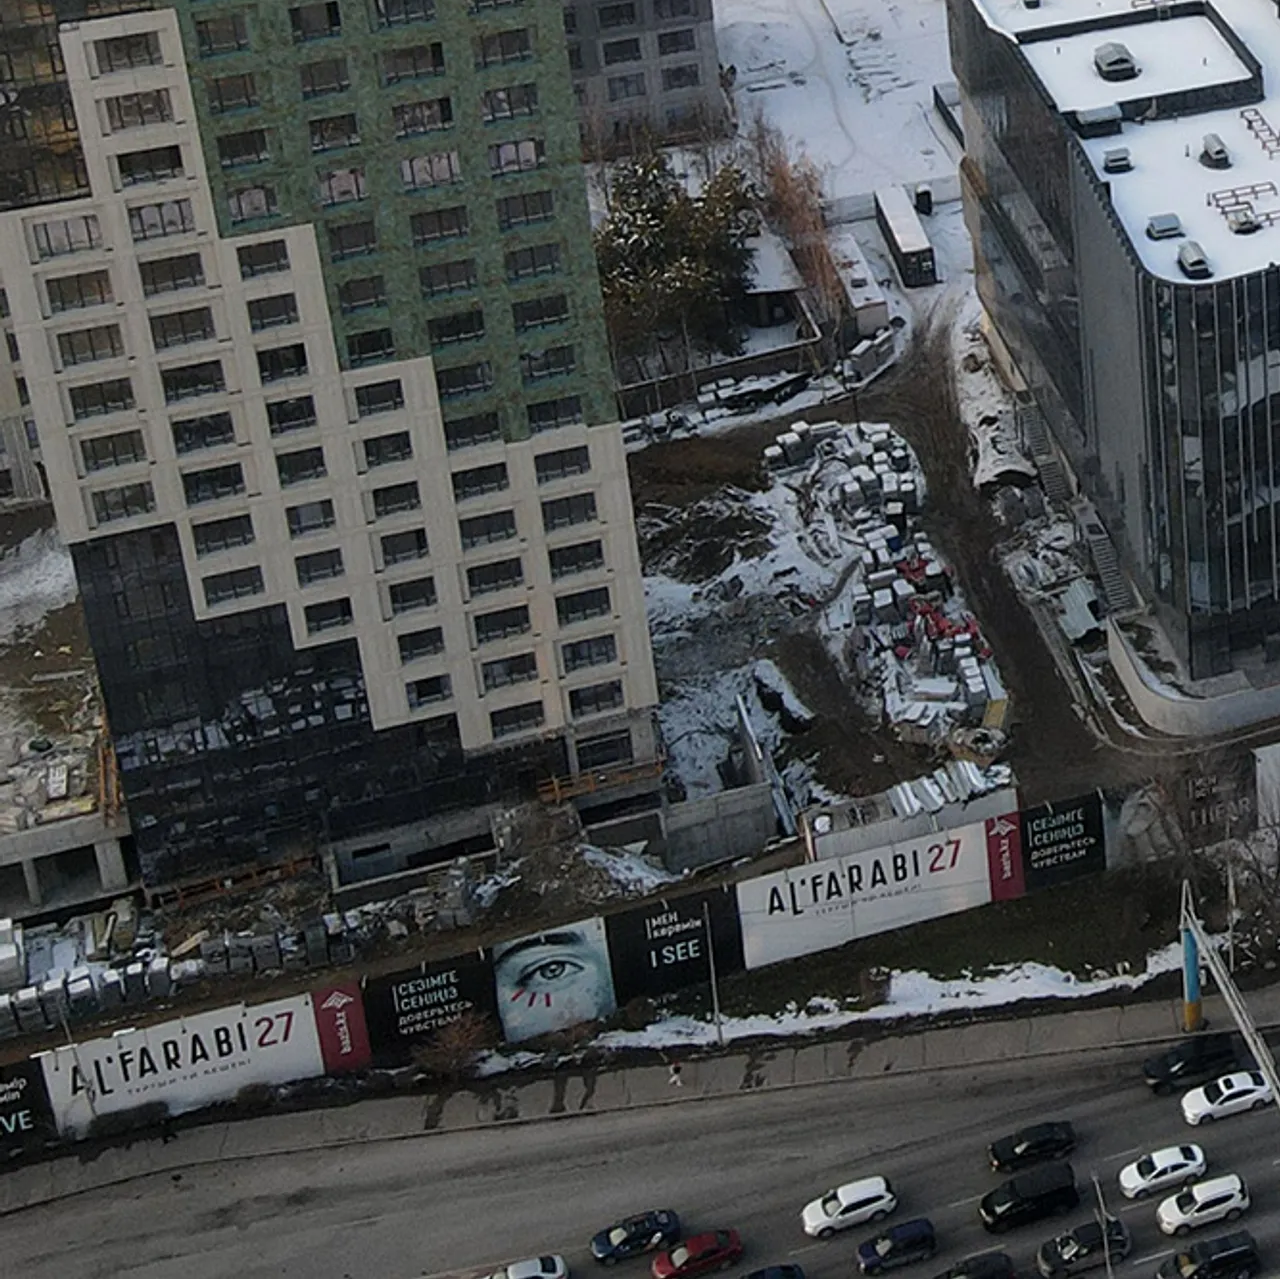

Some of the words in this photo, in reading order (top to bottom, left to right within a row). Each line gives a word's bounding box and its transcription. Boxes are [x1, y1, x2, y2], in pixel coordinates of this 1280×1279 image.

[927, 839, 962, 872] 27
[651, 951, 658, 968] I
[662, 939, 701, 965] SEE
[254, 1011, 295, 1049] 27
